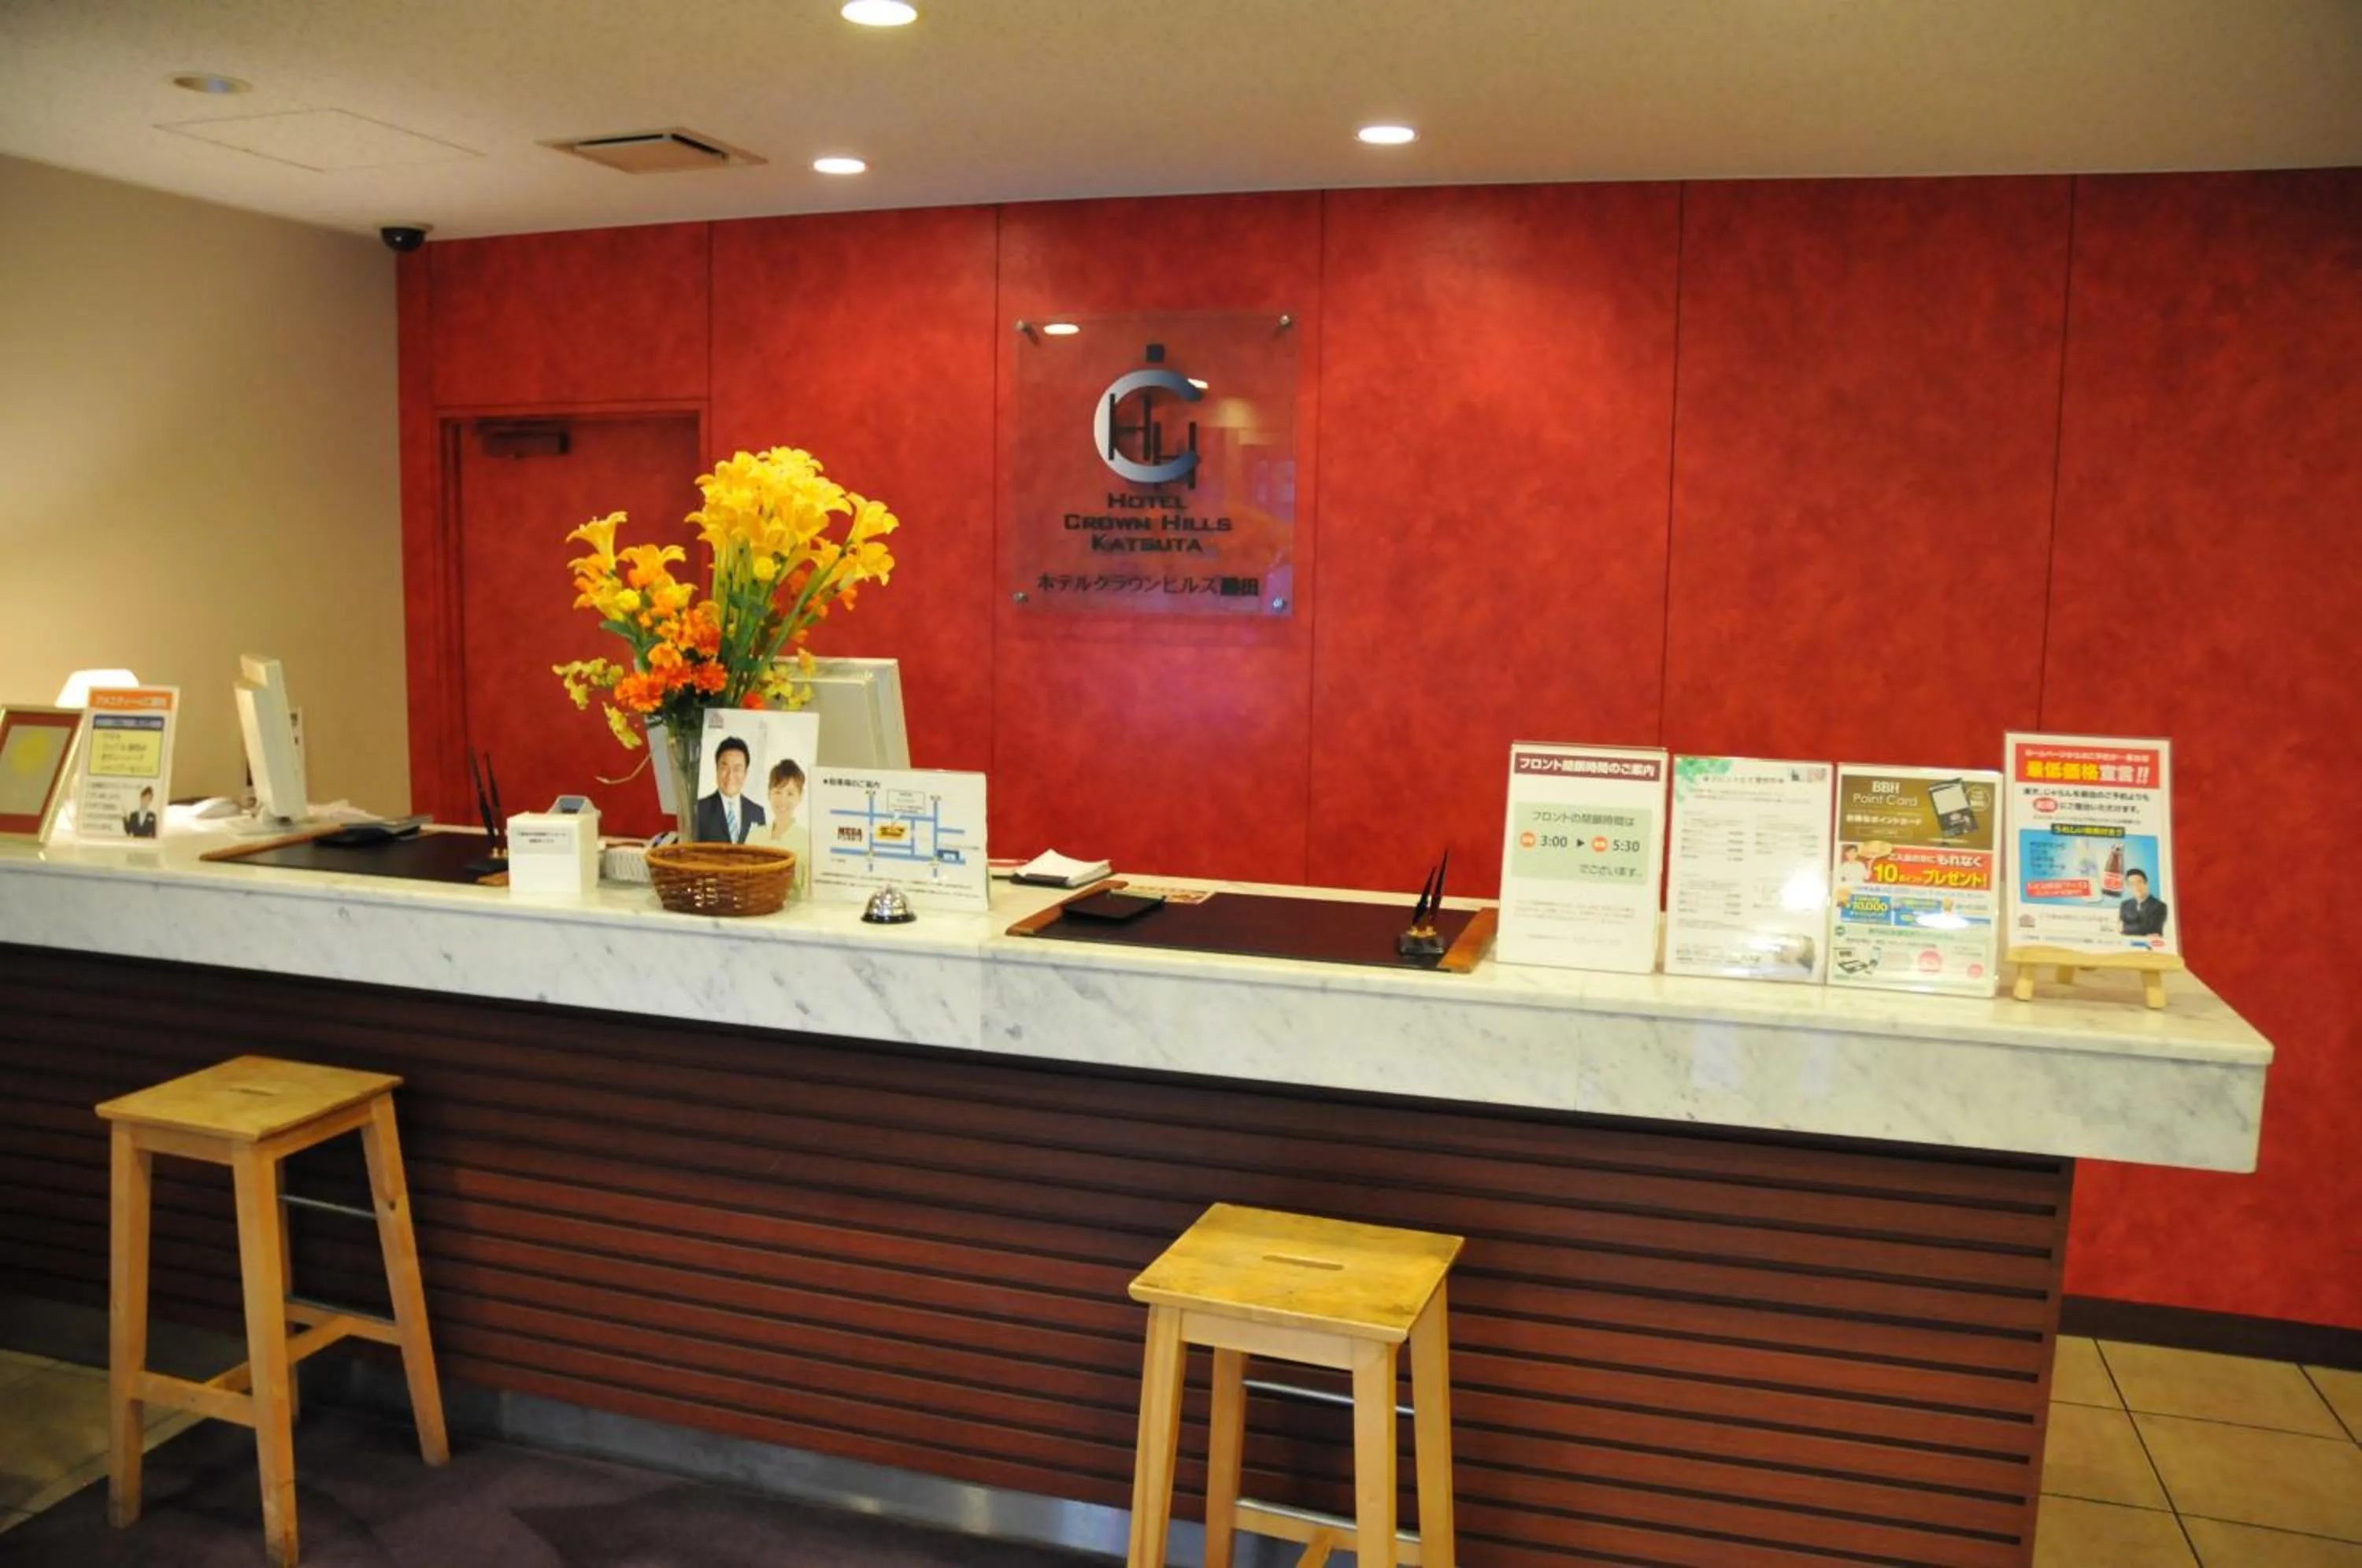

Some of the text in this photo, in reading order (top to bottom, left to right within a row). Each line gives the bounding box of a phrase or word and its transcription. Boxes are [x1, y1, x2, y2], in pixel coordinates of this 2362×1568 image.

[1108, 493, 1188, 509] HOTEL
[1064, 513, 1233, 532] CROWN HILLS
[1091, 535, 1204, 553] KATSUTA
[1871, 780, 1901, 794] BBH
[1852, 793, 1918, 807] Point Card
[1540, 835, 1568, 848] 3:00
[1612, 839, 1641, 852] 5:30
